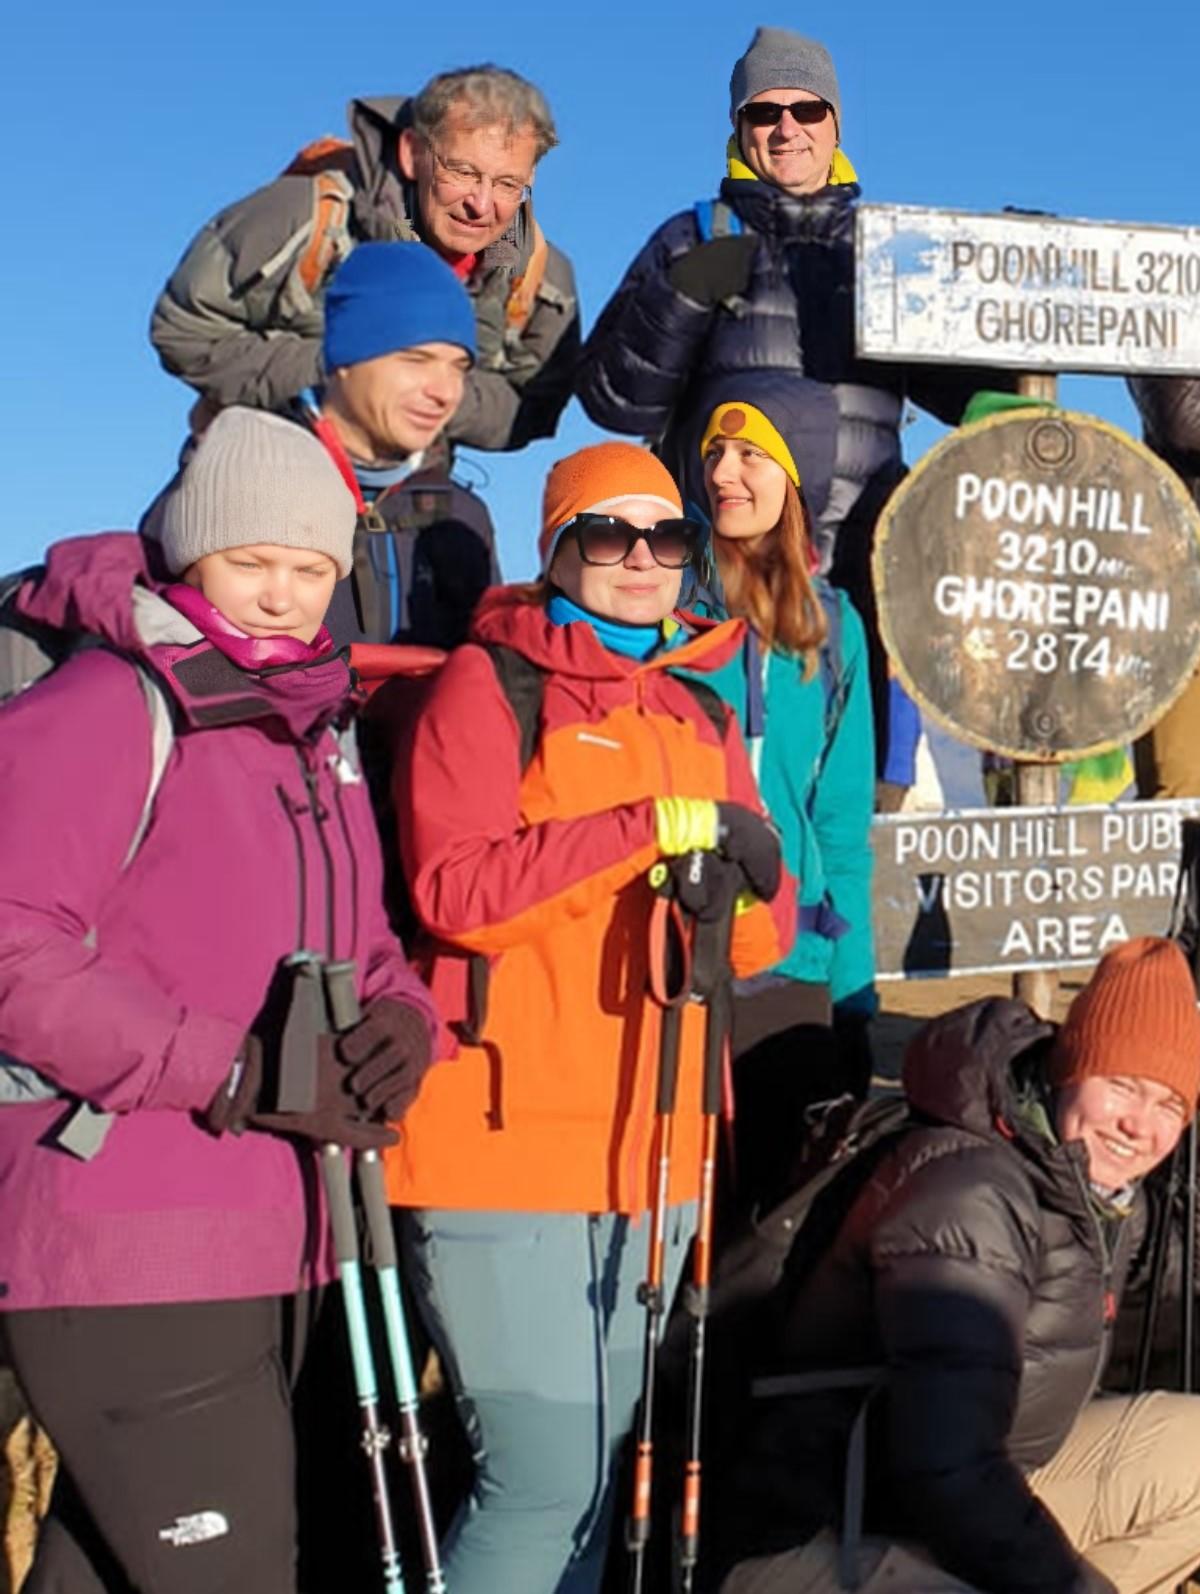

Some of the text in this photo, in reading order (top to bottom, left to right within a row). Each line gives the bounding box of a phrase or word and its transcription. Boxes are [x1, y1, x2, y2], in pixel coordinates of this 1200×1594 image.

[975, 298, 1178, 350] GHOREPANI
[934, 574, 1170, 632] GHOREPANI
[896, 822, 1000, 864] POON
[1009, 817, 1089, 859] HILL
[913, 861, 1188, 914] VISITORS PAR
[1000, 914, 1131, 957] AREA
